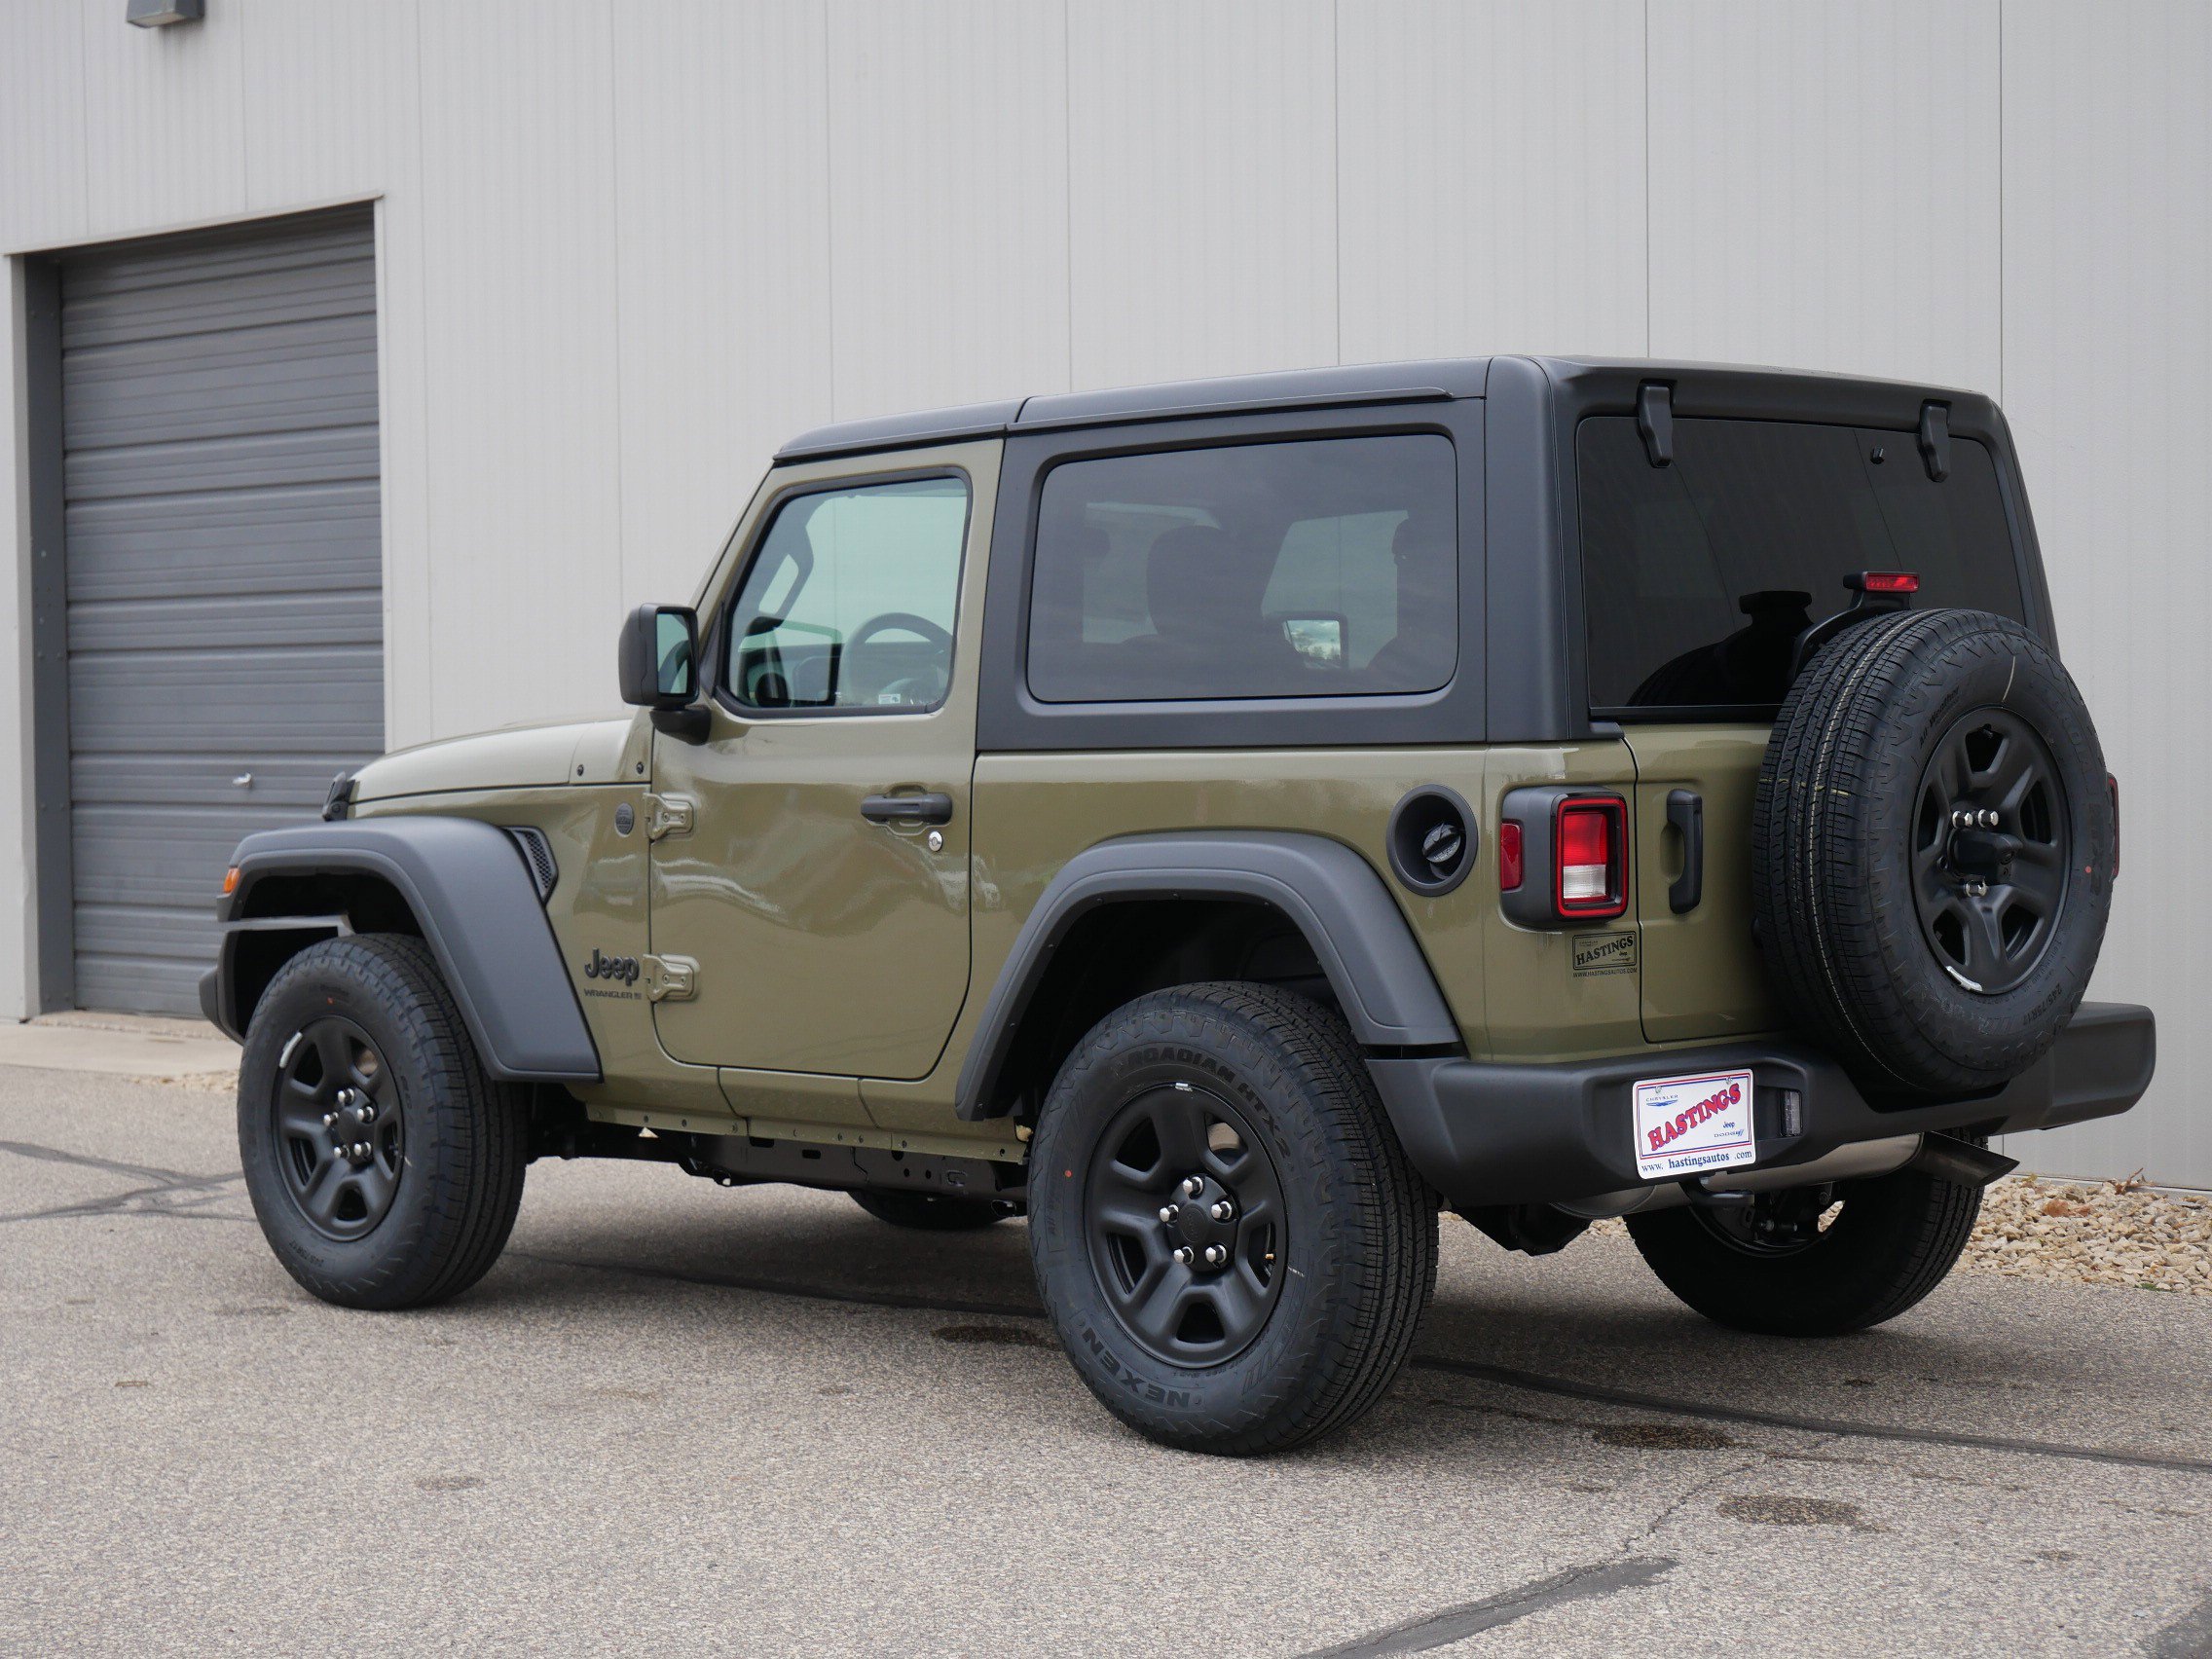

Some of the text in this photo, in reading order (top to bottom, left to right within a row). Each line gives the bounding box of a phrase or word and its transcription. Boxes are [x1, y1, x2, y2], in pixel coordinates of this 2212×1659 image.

[585, 947, 640, 987] Jeep
[1576, 936, 1634, 965] HASTINGS
[584, 988, 633, 1000] WRANGLER
[1647, 1083, 1741, 1151] HASTINGS
[1641, 1162, 1664, 1173] www.
[1668, 1153, 1730, 1168] hastingsautos
[1082, 1327, 1191, 1408] NEXEN
